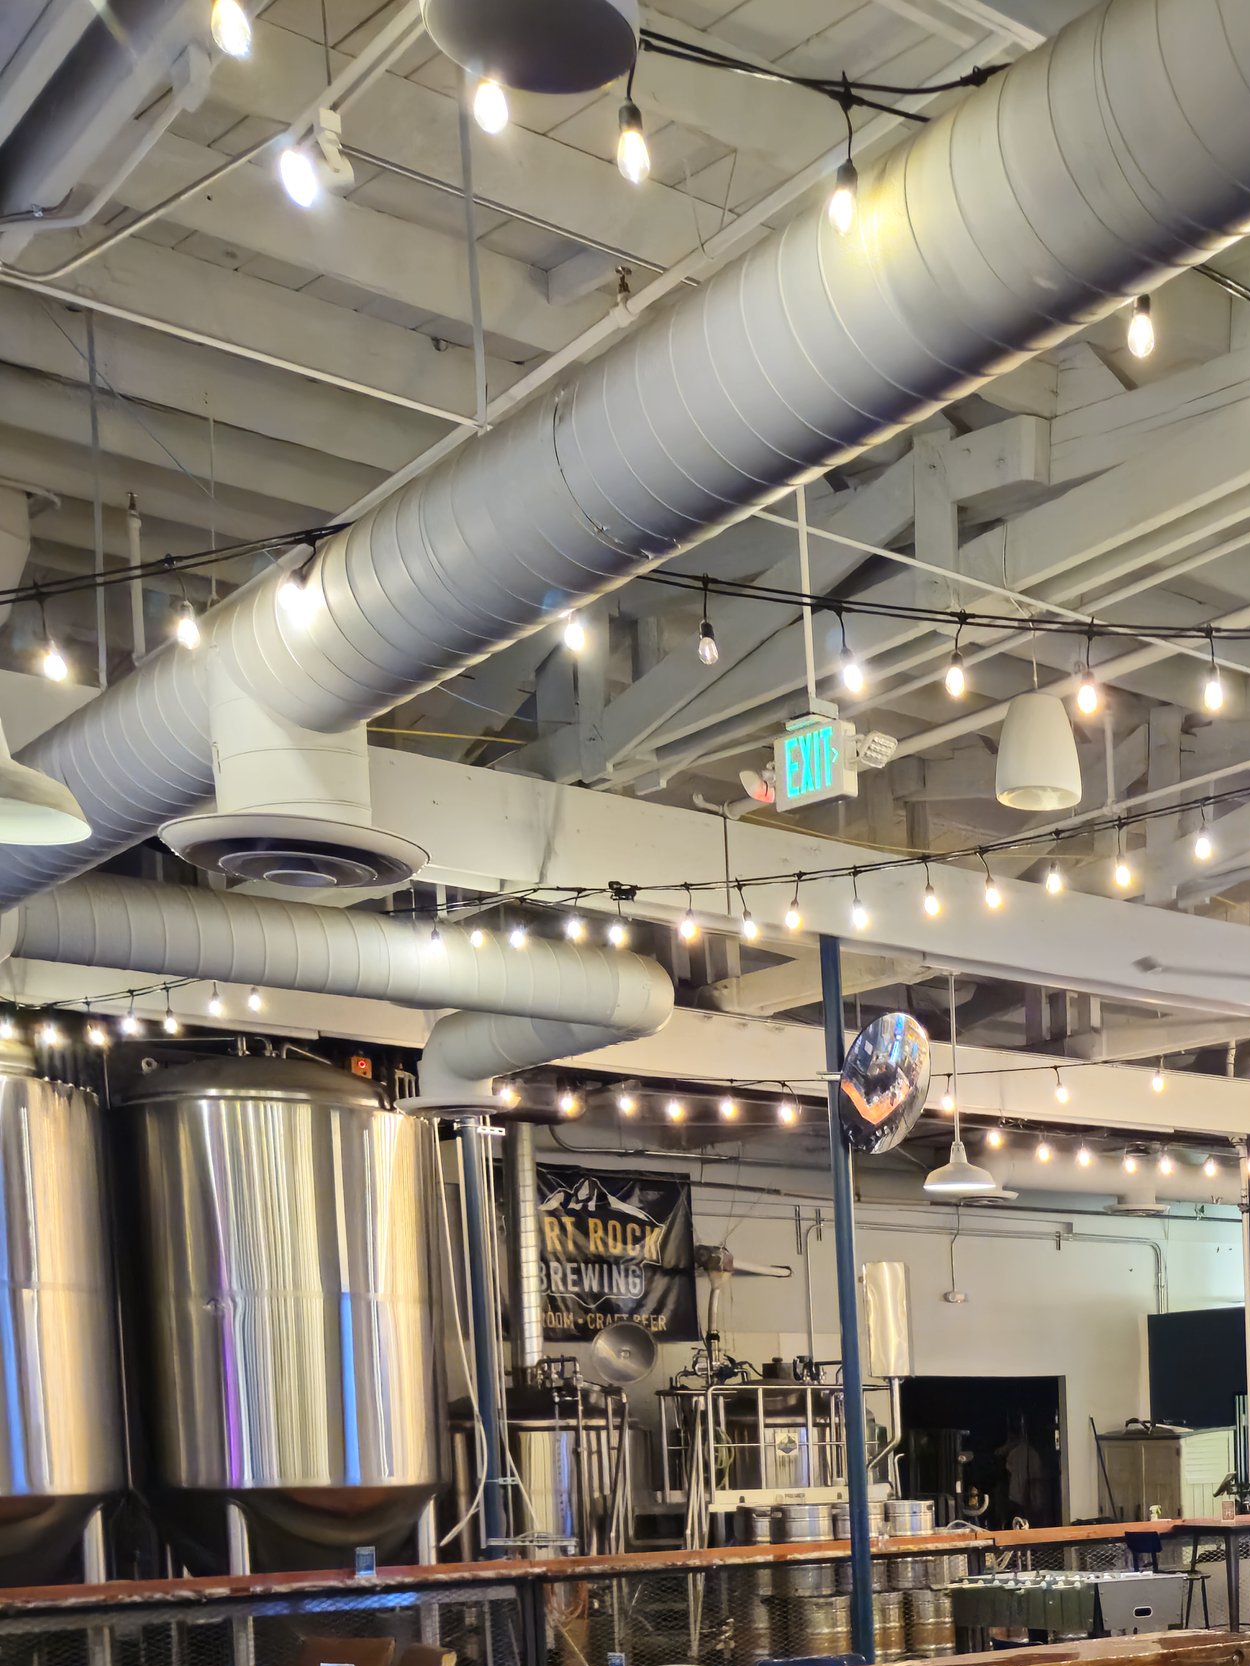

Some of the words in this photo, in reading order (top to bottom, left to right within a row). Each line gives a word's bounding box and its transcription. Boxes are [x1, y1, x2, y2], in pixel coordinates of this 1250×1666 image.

[784, 726, 833, 798] EXIT
[544, 1216, 575, 1253] RT
[588, 1217, 661, 1261] ROCK
